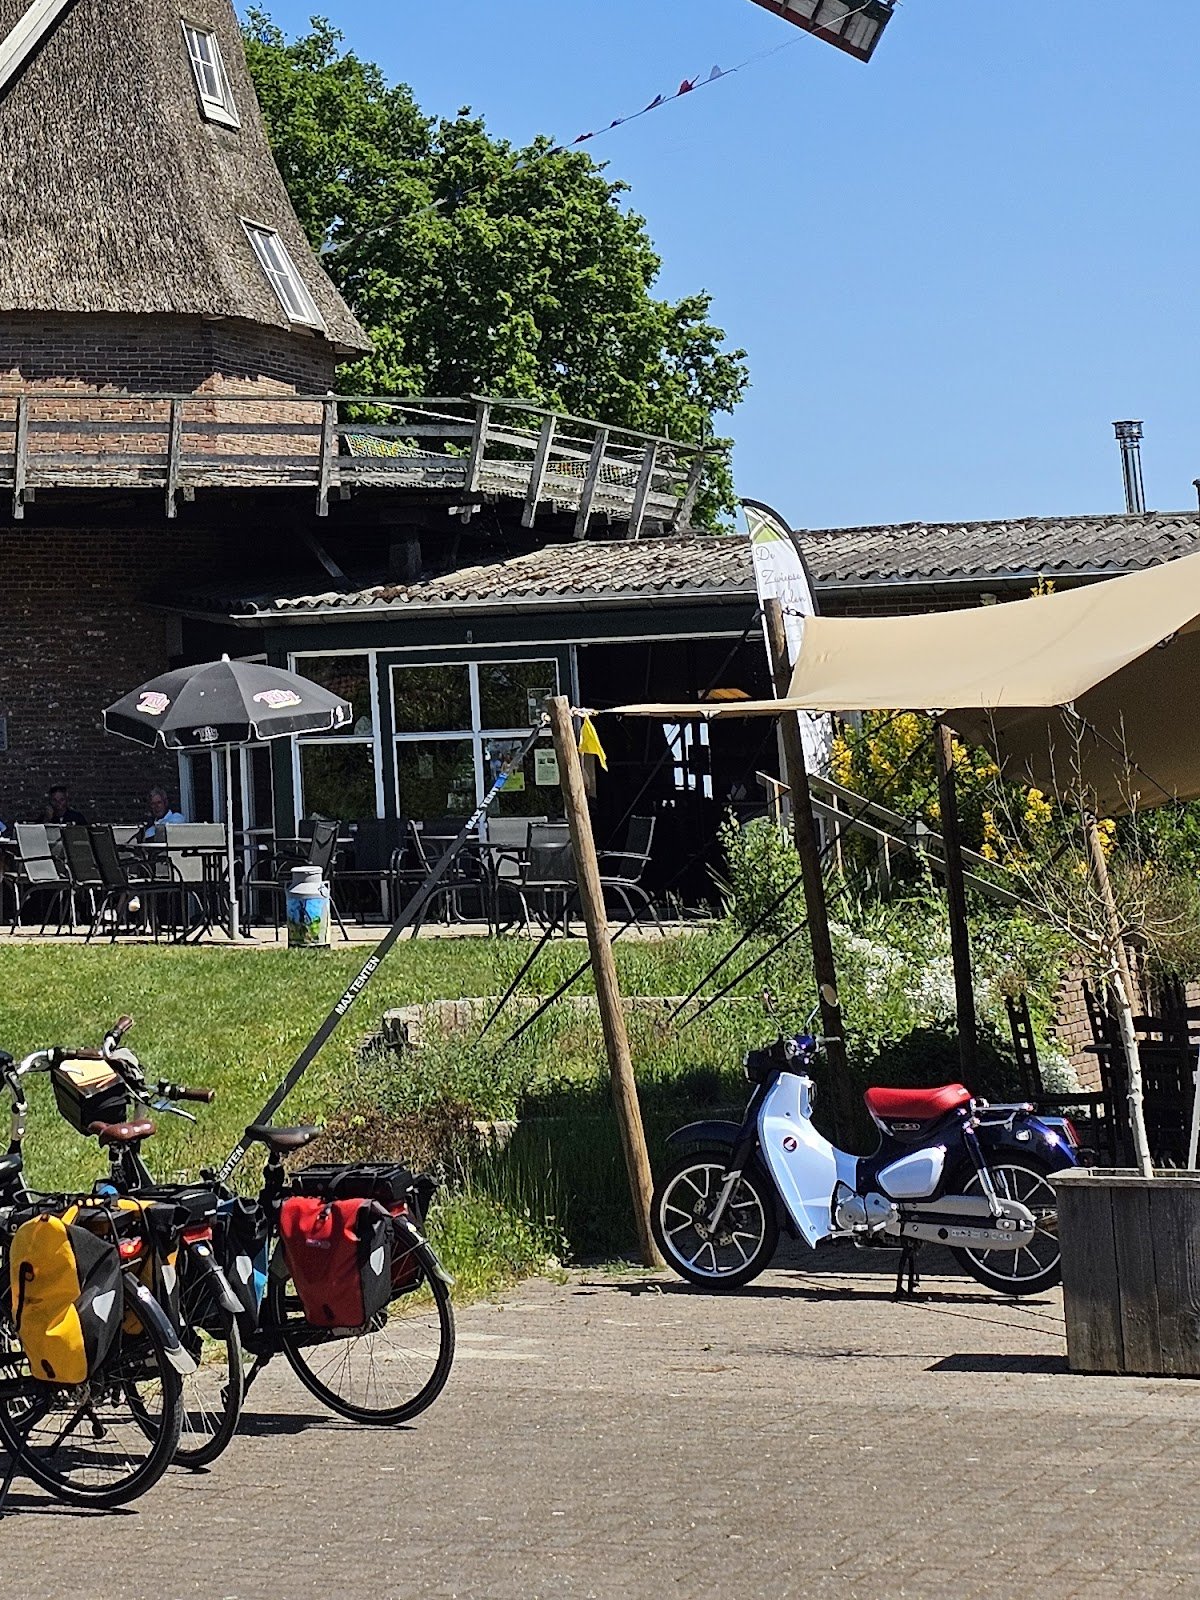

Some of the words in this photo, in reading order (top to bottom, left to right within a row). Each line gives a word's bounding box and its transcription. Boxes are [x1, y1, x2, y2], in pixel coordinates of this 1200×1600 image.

[334, 991, 355, 1015] MAX
[349, 955, 380, 992] TENTEN
[220, 1145, 245, 1180] ENTEN
